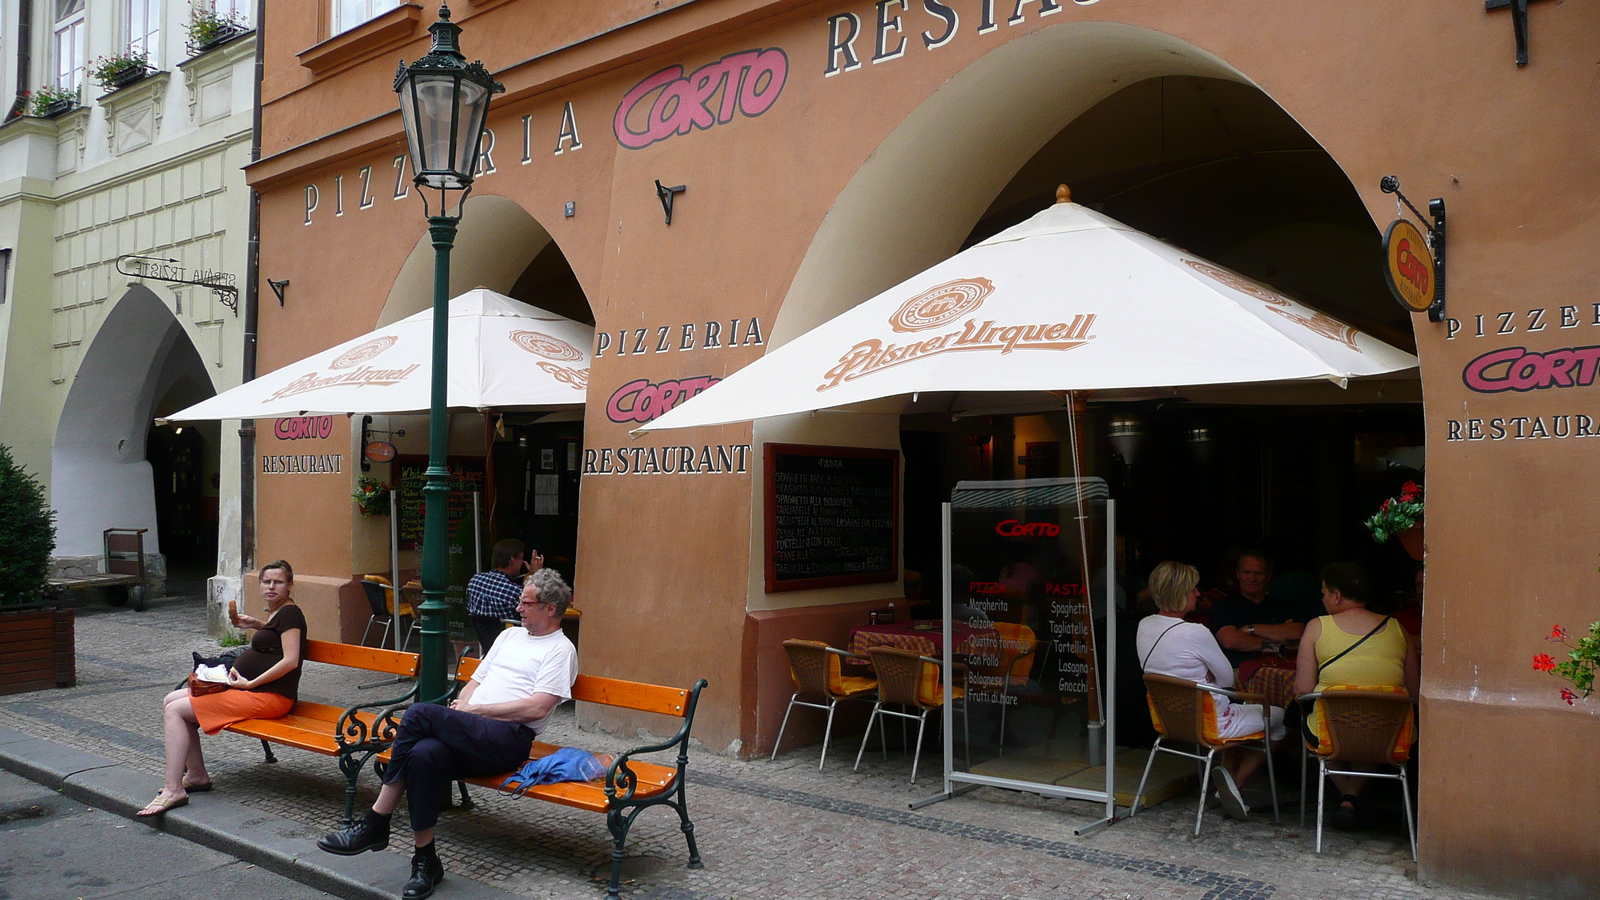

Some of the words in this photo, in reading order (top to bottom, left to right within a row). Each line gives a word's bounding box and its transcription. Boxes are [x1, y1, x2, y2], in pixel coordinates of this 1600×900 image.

[824, 0, 1100, 78] RES
[612, 47, 789, 150] CORTO
[304, 101, 583, 226] PIZZRIA
[1397, 238, 1429, 296] CORTO
[595, 316, 765, 359] PIZZERIA
[816, 331, 965, 393] Pilsner
[950, 313, 1095, 356] Urquell
[1461, 346, 1600, 394] CORT
[261, 372, 352, 404] Pilsner
[341, 363, 421, 390] Urquell
[606, 375, 724, 423] CORT
[1447, 414, 1600, 443] RESTAUR
[262, 454, 343, 475] RESTAURANT
[583, 444, 753, 476] RESTAURANT
[817, 458, 845, 470] PASTA
[776, 494, 808, 505] SPAGHETTI
[810, 496, 822, 506] ALLA
[776, 505, 811, 515] TAGLIATELLE
[776, 515, 810, 525] TAGLIATELLE
[836, 517, 861, 527] LASAGNE
[995, 519, 1061, 537] CORTO
[776, 538, 811, 550] TORTELLINI
[969, 581, 1007, 594] PIZZA
[1045, 583, 1089, 596] PASTA
[968, 598, 1008, 614] Margherita
[1051, 601, 1088, 618] Spaghetti
[968, 618, 995, 631] Calzone
[1049, 620, 1088, 638] Tagliatelle
[968, 634, 1002, 648] Quattro
[1053, 639, 1088, 654] Tortellini
[968, 653, 981, 666] Con
[982, 654, 999, 667] Pollo
[1058, 658, 1088, 677] Lasagna
[968, 672, 1003, 688] Bolognese
[1058, 677, 1088, 693] Gnocchi
[968, 690, 990, 703] Frutti
